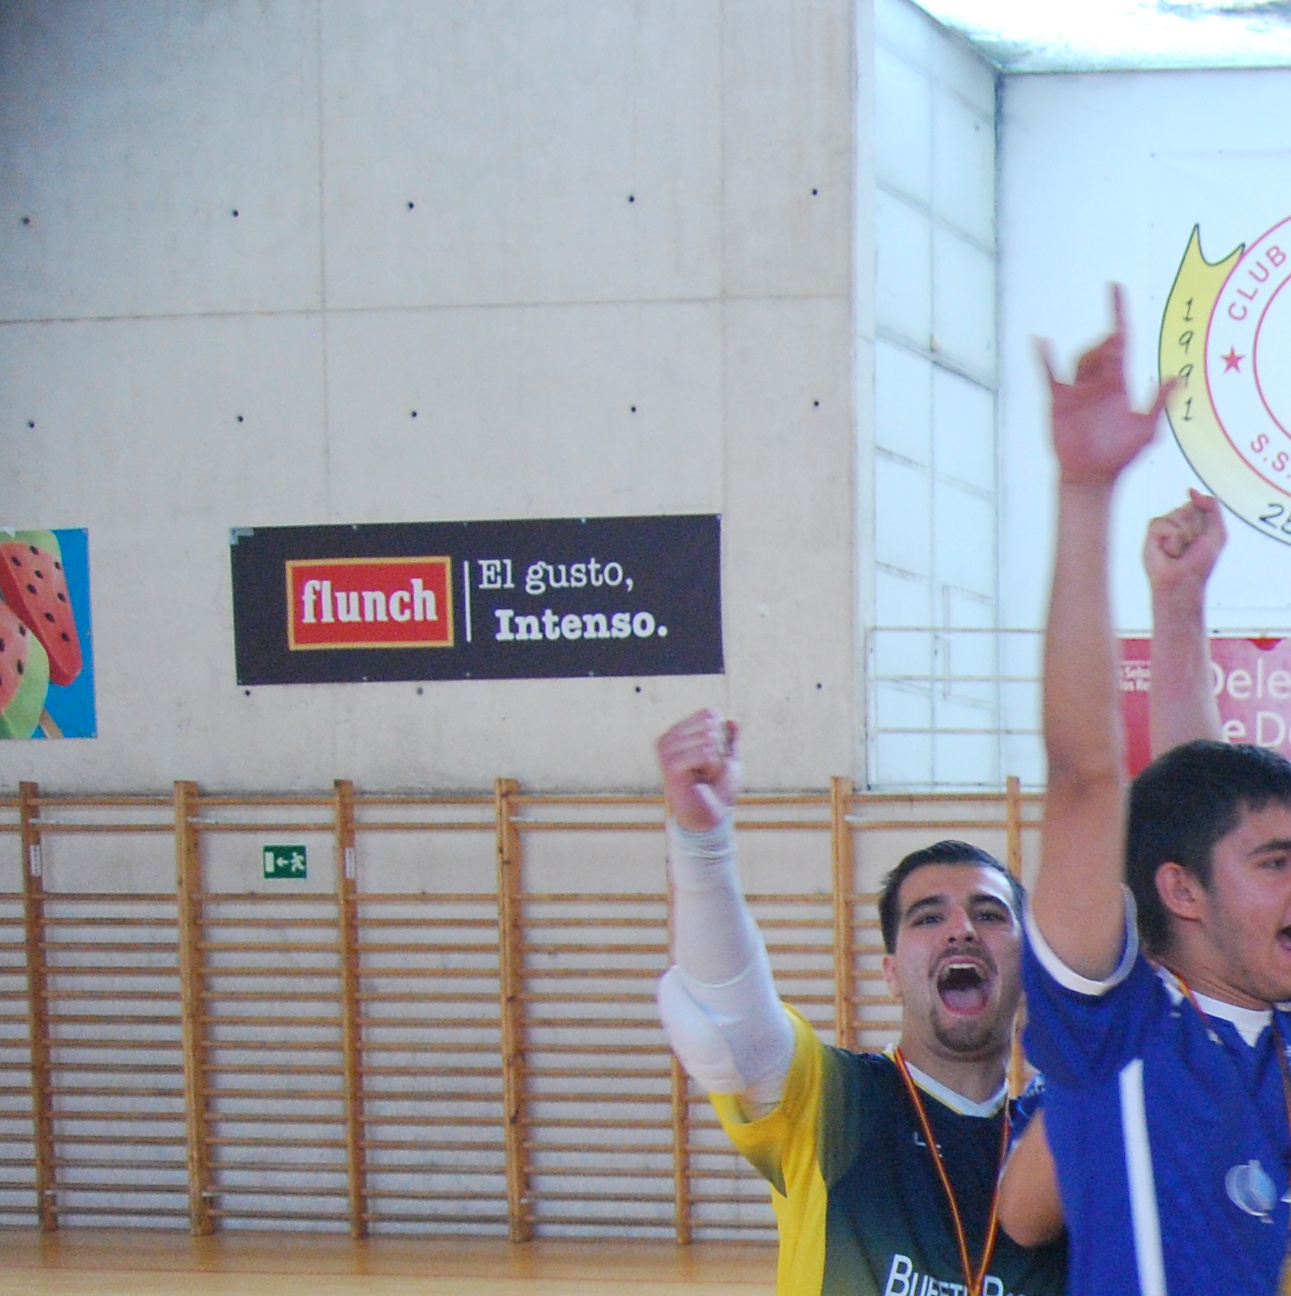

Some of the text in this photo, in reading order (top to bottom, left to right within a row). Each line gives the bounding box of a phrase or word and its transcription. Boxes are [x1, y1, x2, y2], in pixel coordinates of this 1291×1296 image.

[1227, 246, 1288, 321] CLUB
[478, 557, 634, 595] El gusto,
[302, 578, 437, 624] flunch
[494, 608, 668, 642] Intenso.
